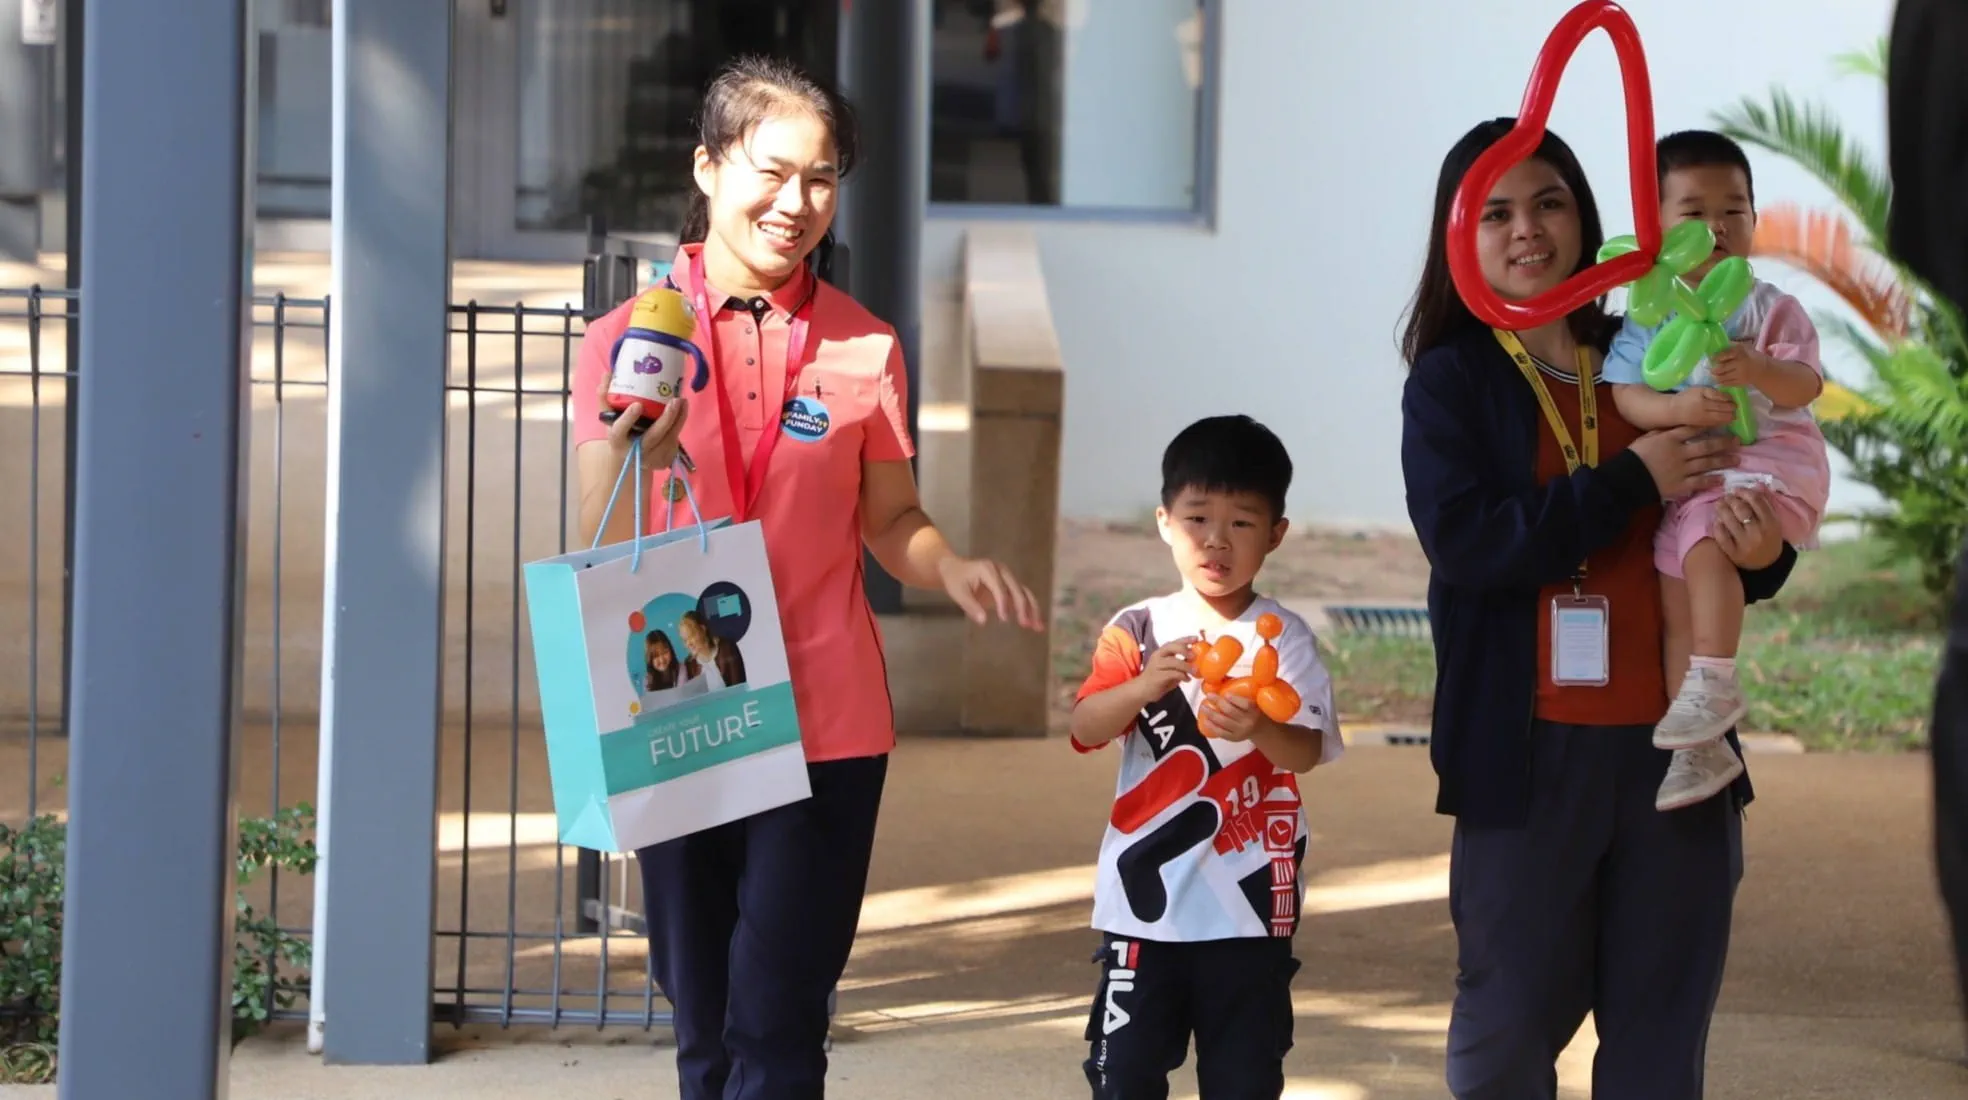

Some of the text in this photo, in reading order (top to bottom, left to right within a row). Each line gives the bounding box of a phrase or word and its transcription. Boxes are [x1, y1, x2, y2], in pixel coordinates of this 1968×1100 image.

[785, 419, 823, 433] FUNDAY
[787, 411, 820, 424] FAMILY
[649, 699, 763, 767] FUTURE
[1225, 775, 1261, 817] 19
[1102, 941, 1141, 1036] FILA
